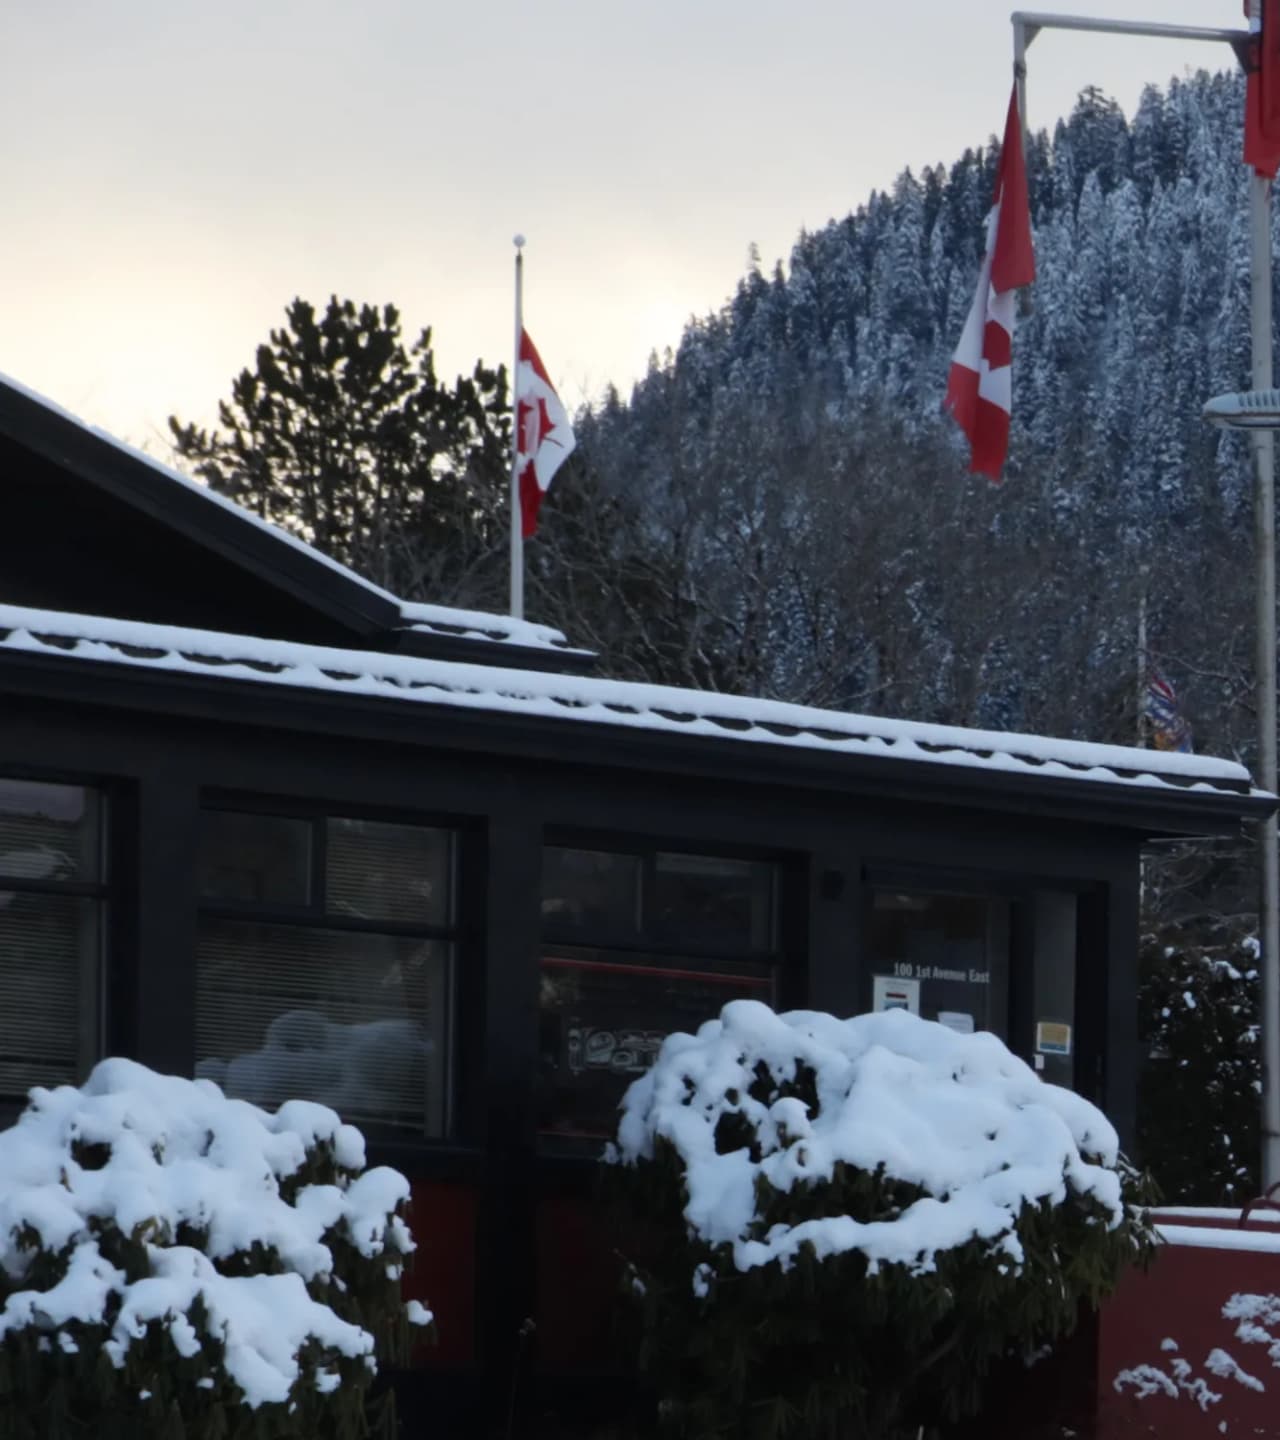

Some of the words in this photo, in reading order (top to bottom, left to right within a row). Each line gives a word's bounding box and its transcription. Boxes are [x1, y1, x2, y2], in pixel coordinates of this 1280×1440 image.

[894, 962, 913, 977] 100
[916, 965, 931, 979] 1st
[933, 966, 966, 982] Avenue
[969, 969, 991, 984] East
